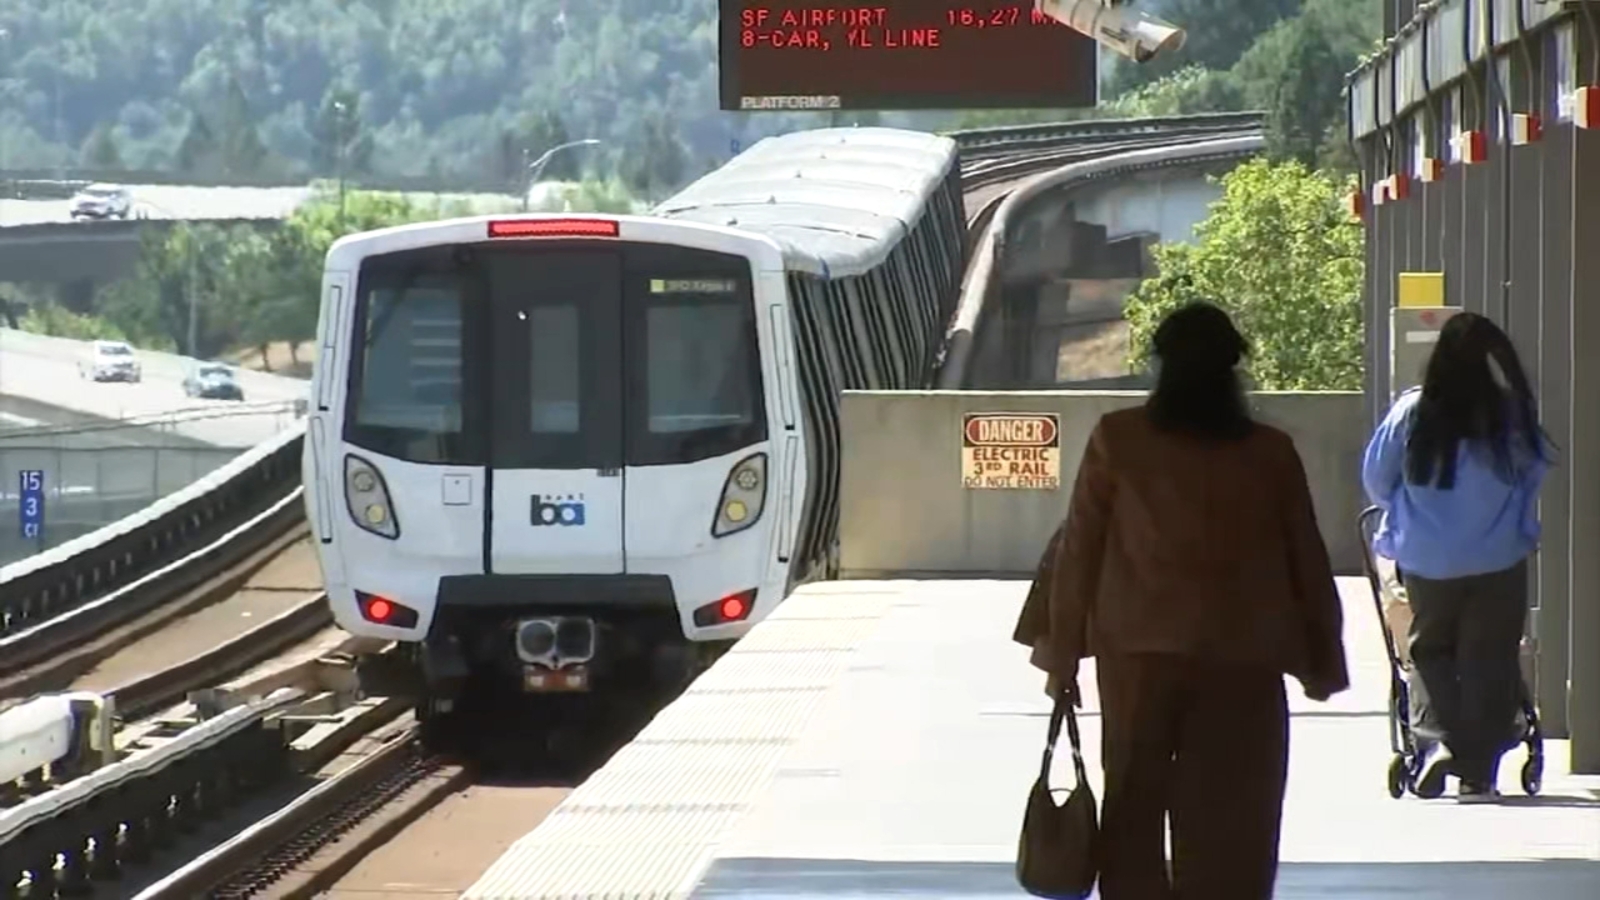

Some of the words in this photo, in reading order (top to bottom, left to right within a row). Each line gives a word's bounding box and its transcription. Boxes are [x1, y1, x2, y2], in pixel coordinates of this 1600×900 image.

[742, 9, 769, 26] SF
[742, 30, 830, 50] 8-CAR,
[886, 29, 939, 47] LINE
[741, 96, 822, 109] PLATFORM
[829, 96, 840, 108] 2
[980, 420, 1043, 441] DANGER
[973, 448, 1050, 461] ELECTRIC
[974, 462, 1002, 475] 3RD
[1009, 461, 1050, 476] RAIL
[23, 472, 40, 490] 15
[965, 476, 982, 488] DO
[986, 476, 1012, 488] NOT
[1017, 475, 1057, 488] ENTER
[26, 497, 37, 516] 3
